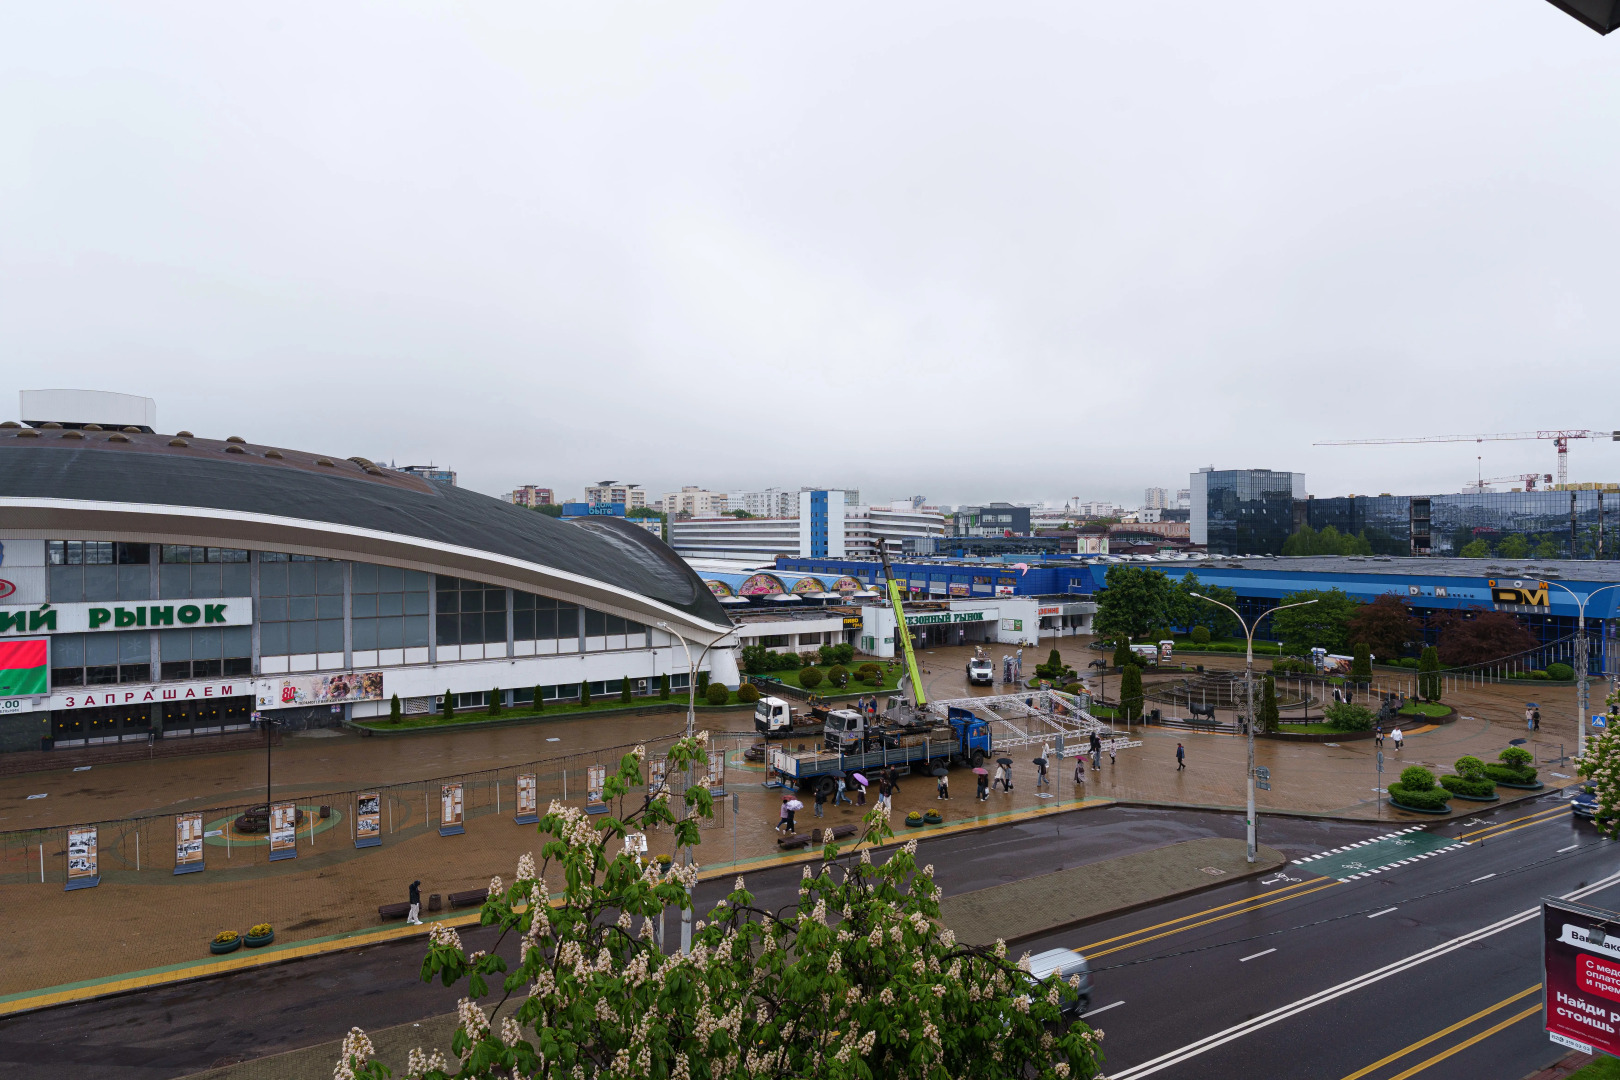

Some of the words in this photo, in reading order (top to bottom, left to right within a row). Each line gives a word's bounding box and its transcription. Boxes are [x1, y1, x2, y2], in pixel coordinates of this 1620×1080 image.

[88, 604, 228, 629] РЫНОК
[953, 612, 984, 623] РЫНОК
[65, 685, 233, 707] ЗАПРАШАЕМ
[281, 686, 296, 701] 80
[1556, 991, 1606, 1017] Найди
[1556, 1007, 1615, 1034] стоишь
